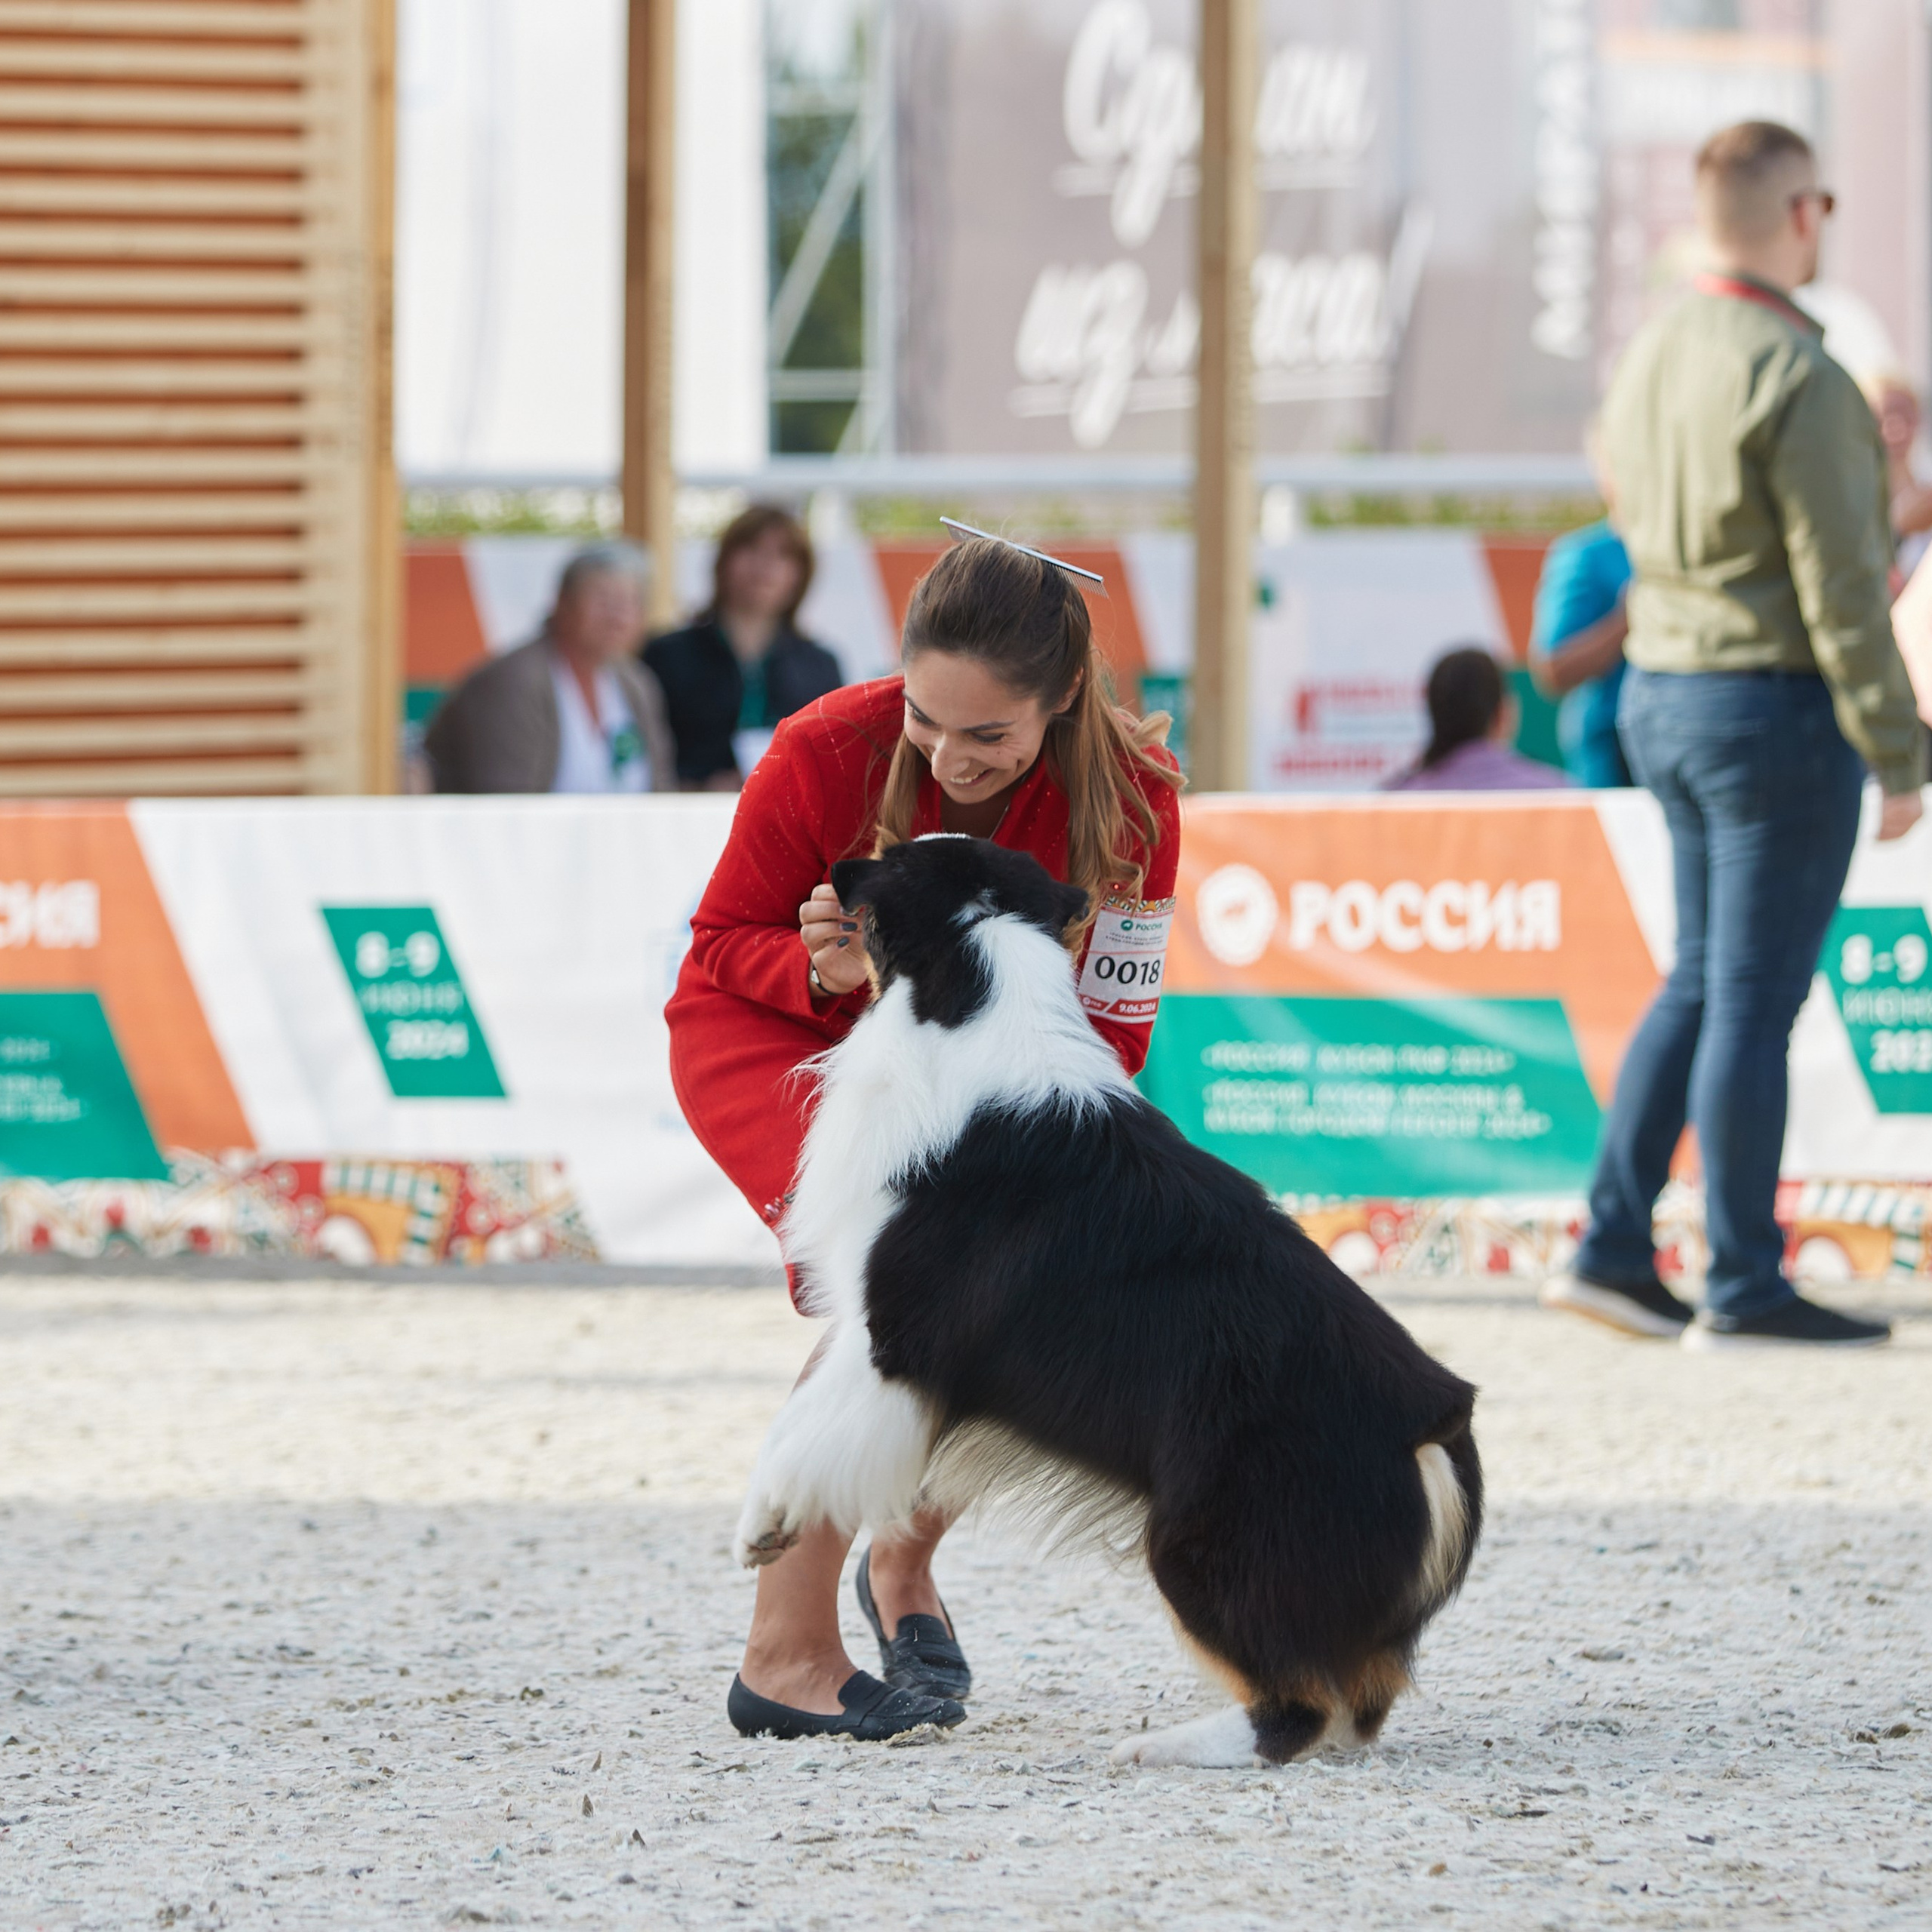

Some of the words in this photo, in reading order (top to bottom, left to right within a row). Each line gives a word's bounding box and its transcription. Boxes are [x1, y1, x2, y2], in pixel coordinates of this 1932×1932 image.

[1287, 878, 1562, 952] РОССИЯ
[1094, 955, 1161, 986] 0018
[1118, 1001, 1157, 1014] 9.06.2024
[1869, 1029, 1932, 1074] 202
